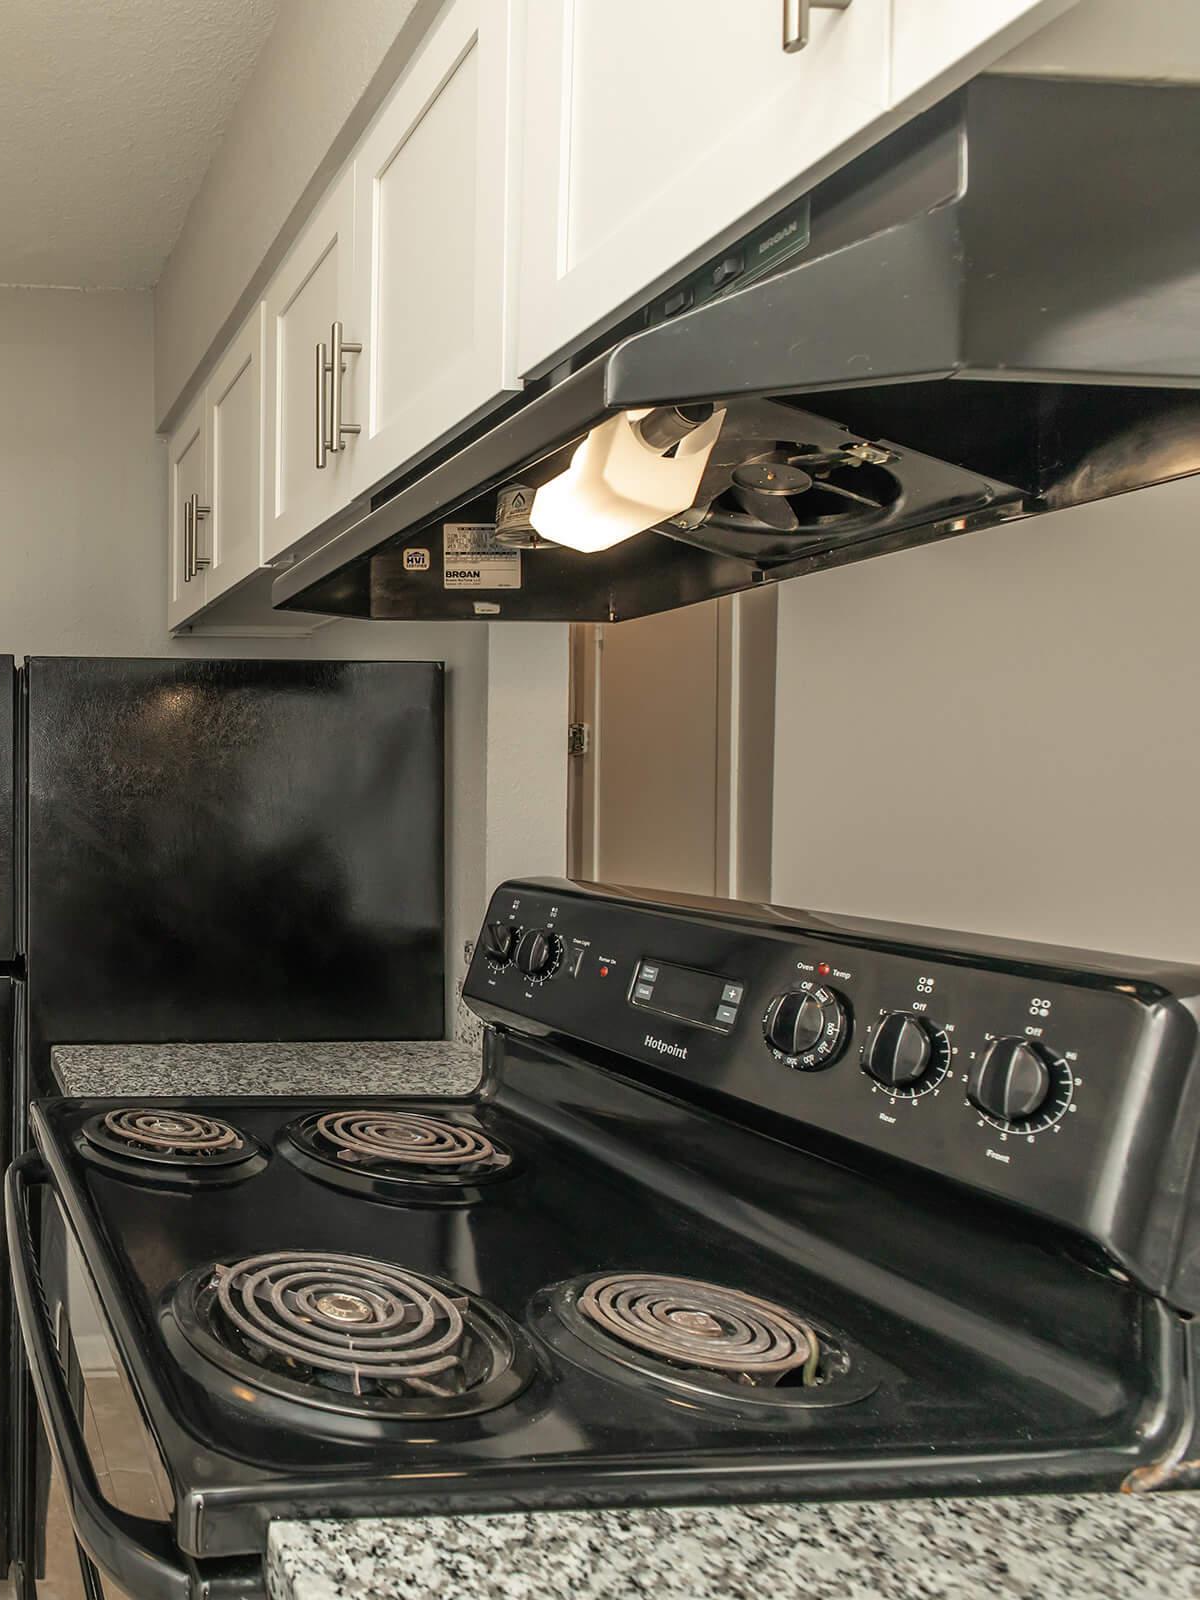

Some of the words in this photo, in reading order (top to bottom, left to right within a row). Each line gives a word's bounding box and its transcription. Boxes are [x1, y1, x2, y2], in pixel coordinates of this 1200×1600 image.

[759, 220, 798, 254] BROAN
[406, 556, 425, 564] HVI
[445, 570, 481, 579] BROAN
[796, 961, 814, 972] Oven
[832, 968, 851, 980] Temp
[801, 981, 814, 991] Off
[912, 1001, 927, 1012] Off
[1024, 1025, 1043, 1037] Off
[644, 1034, 688, 1060] Hotpoint
[1065, 1051, 1078, 1061] Hi
[1074, 1077, 1082, 1087] 9
[889, 1097, 896, 1105] 5
[911, 1098, 918, 1107] 6
[879, 1111, 896, 1124] Rear
[977, 1119, 984, 1127] 4
[1053, 1124, 1061, 1133] 7
[1000, 1133, 1007, 1141] 5
[1027, 1135, 1035, 1143] 6
[986, 1149, 1010, 1164] Front
